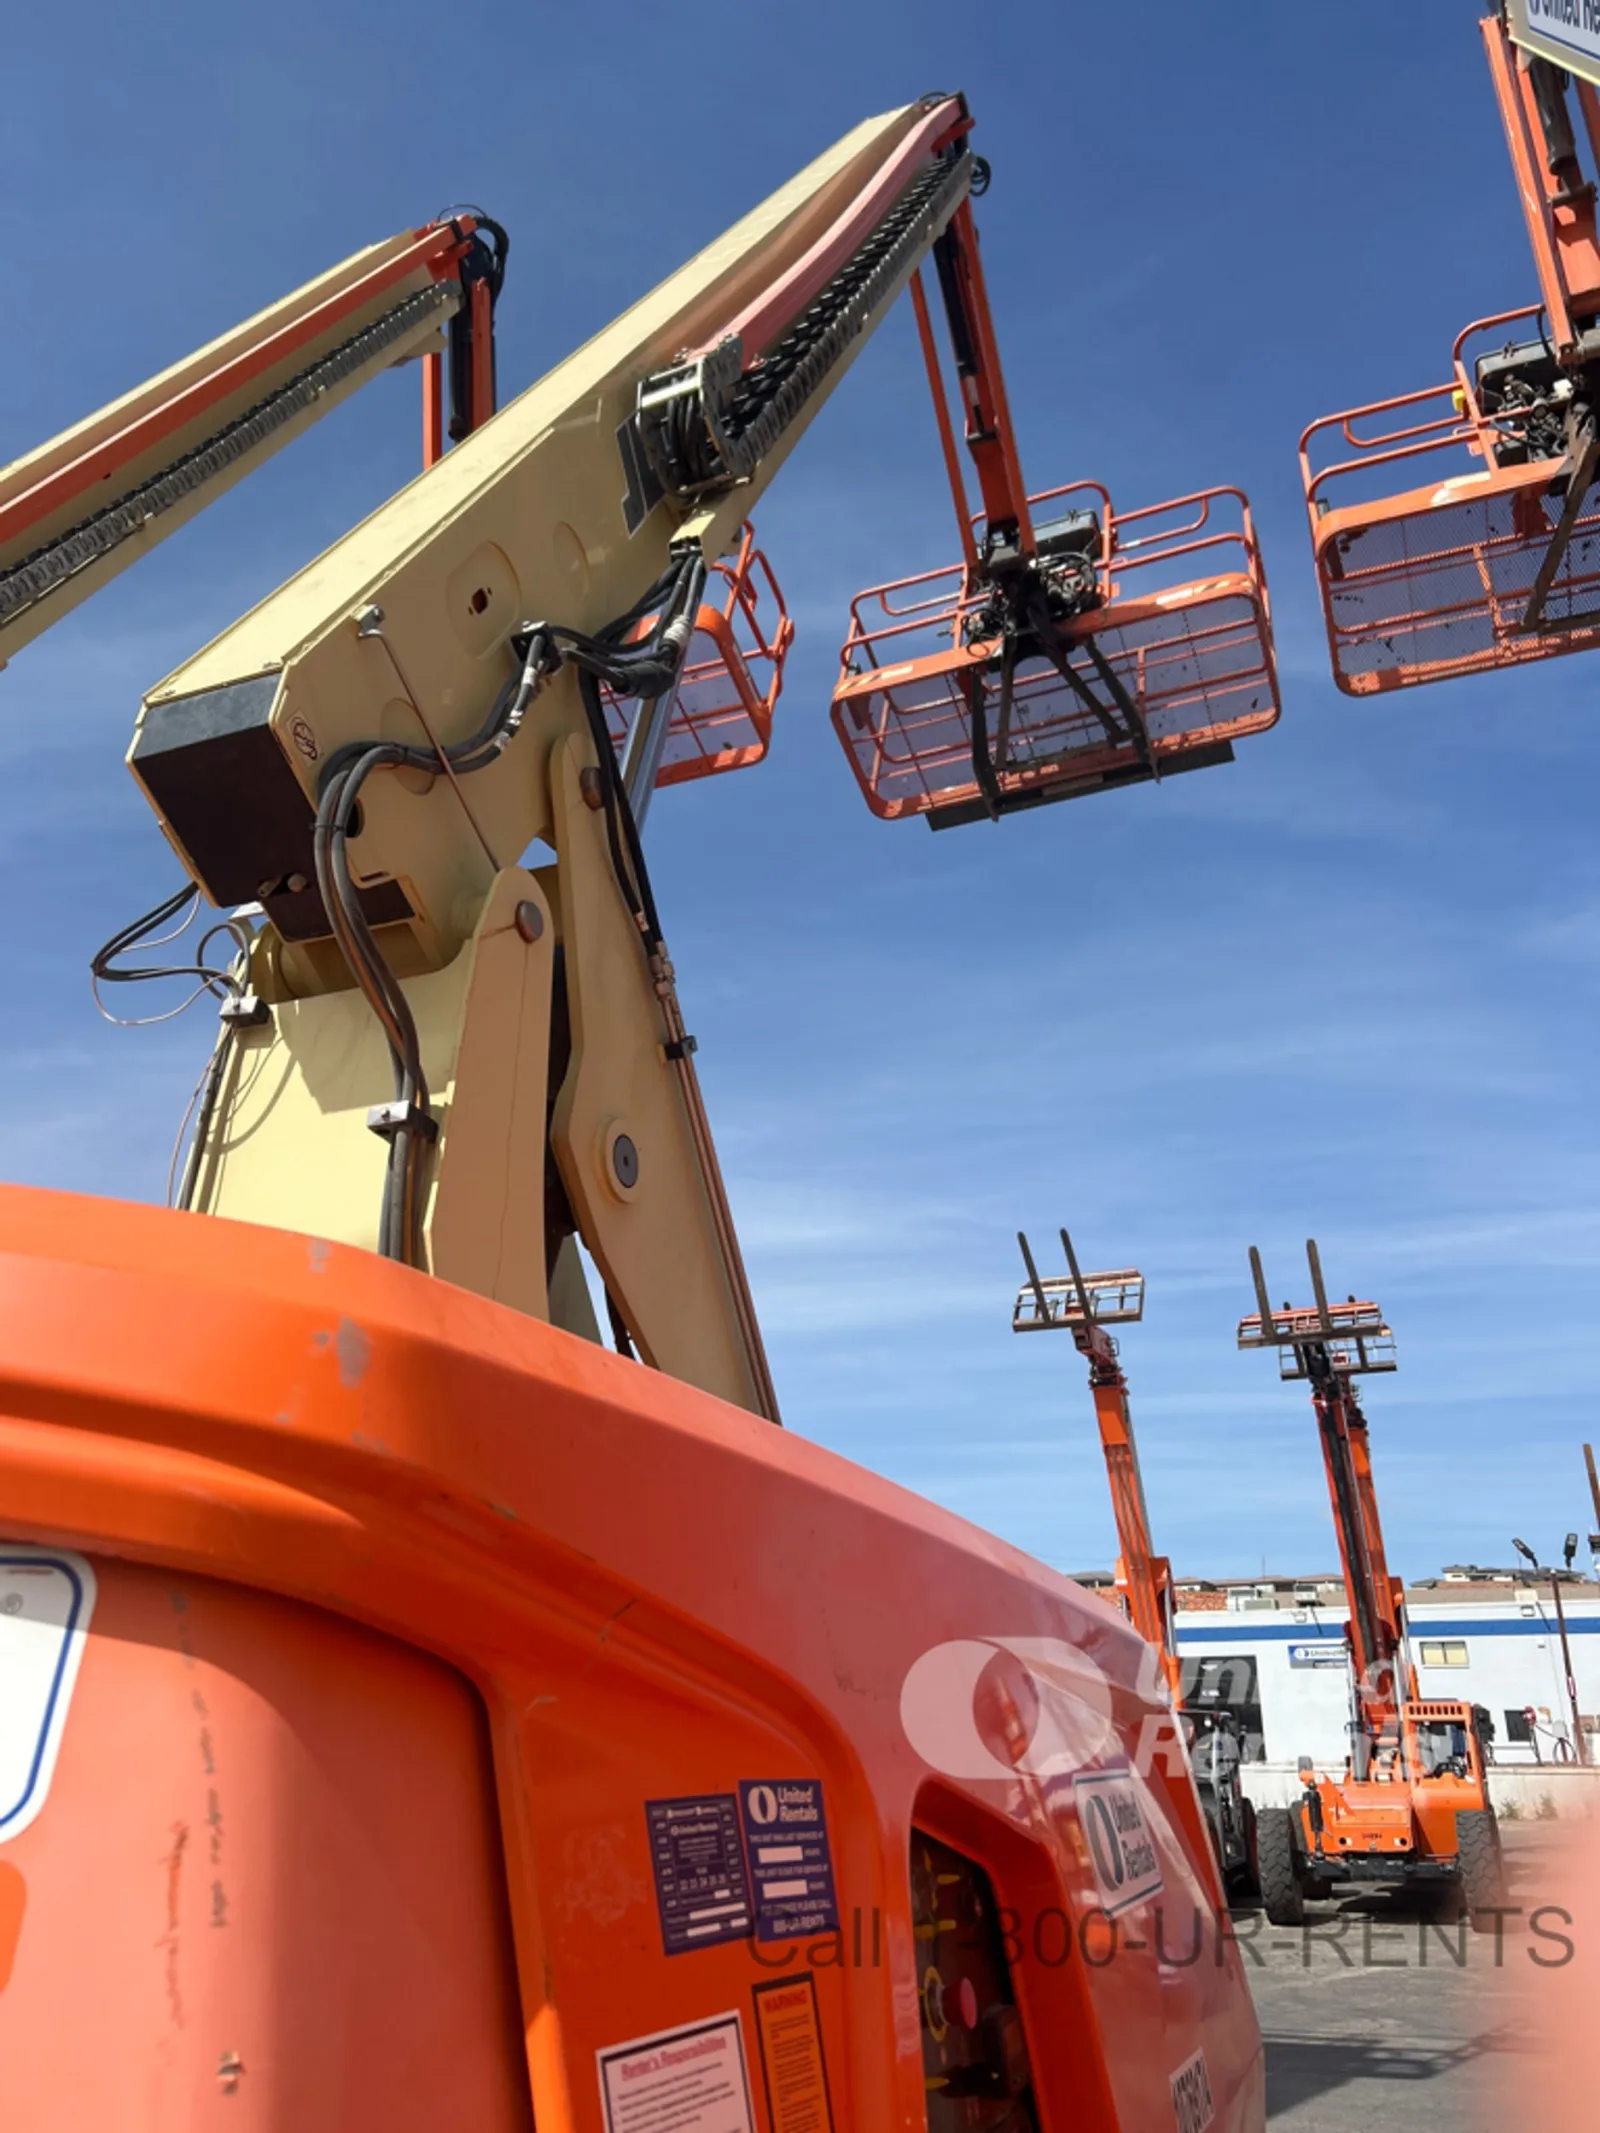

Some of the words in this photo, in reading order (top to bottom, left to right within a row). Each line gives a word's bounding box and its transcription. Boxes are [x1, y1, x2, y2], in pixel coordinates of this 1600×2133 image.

[778, 1786, 813, 1803] United
[780, 1804, 819, 1822] Rentals
[1108, 1791, 1142, 1834] United
[1121, 1836, 1157, 1881] Rentals
